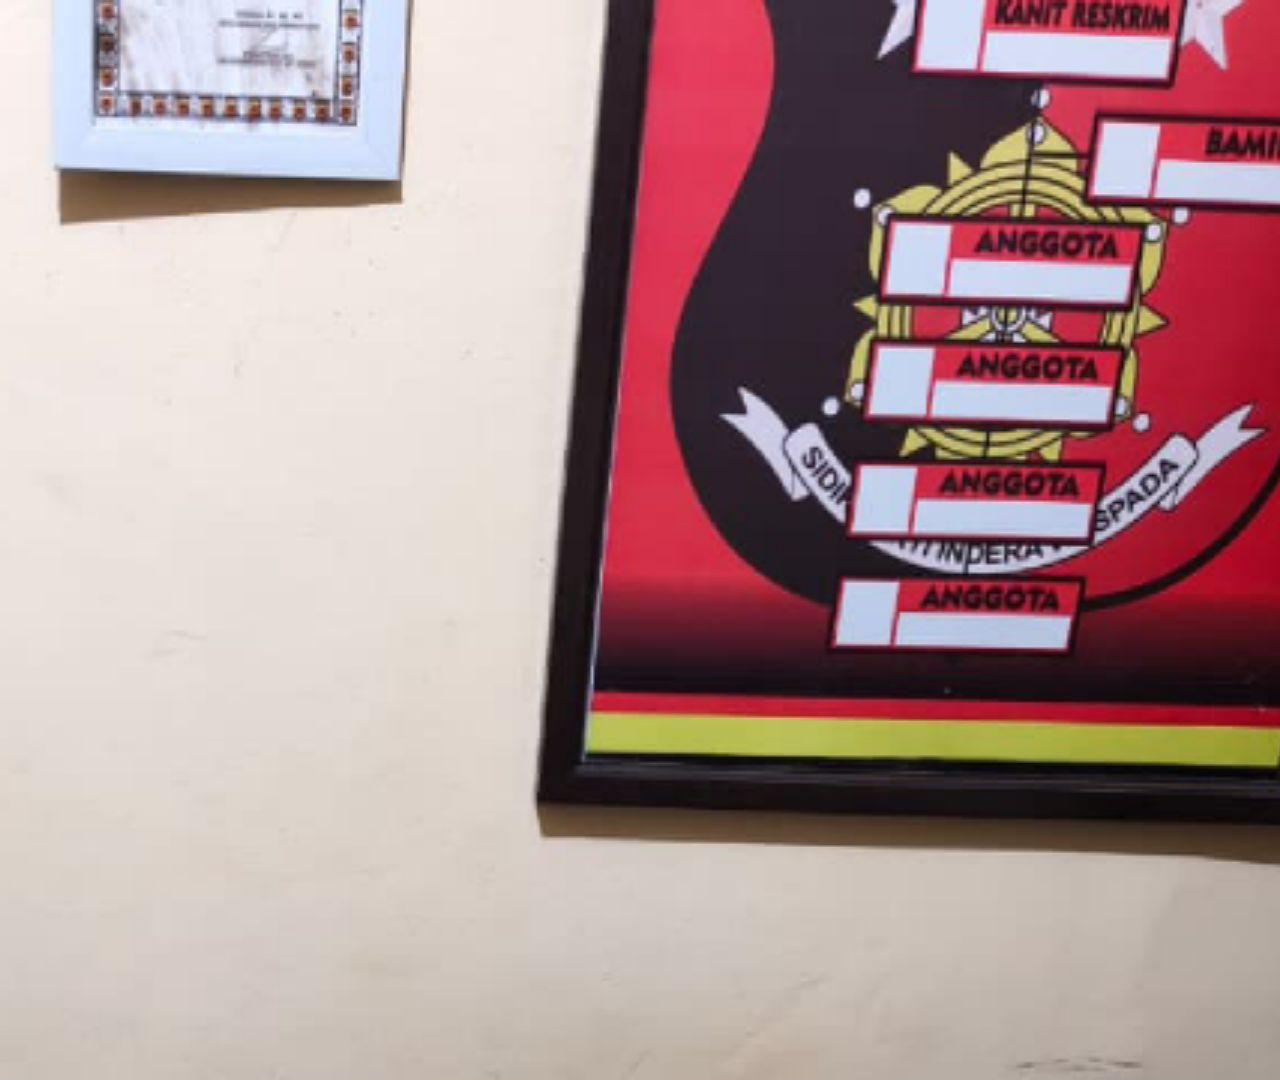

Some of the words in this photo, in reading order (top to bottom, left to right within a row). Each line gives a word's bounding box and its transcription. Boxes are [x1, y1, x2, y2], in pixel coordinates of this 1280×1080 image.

[995, 0, 1067, 25] KANIT
[1072, 2, 1170, 32] RESKRIM
[1205, 126, 1280, 159] BAMI
[975, 229, 1118, 258] ANGGOTA
[957, 352, 1098, 381] ANGGOTA
[939, 469, 1080, 497] ANGGOTA
[920, 584, 1060, 612] ANGGOTA
